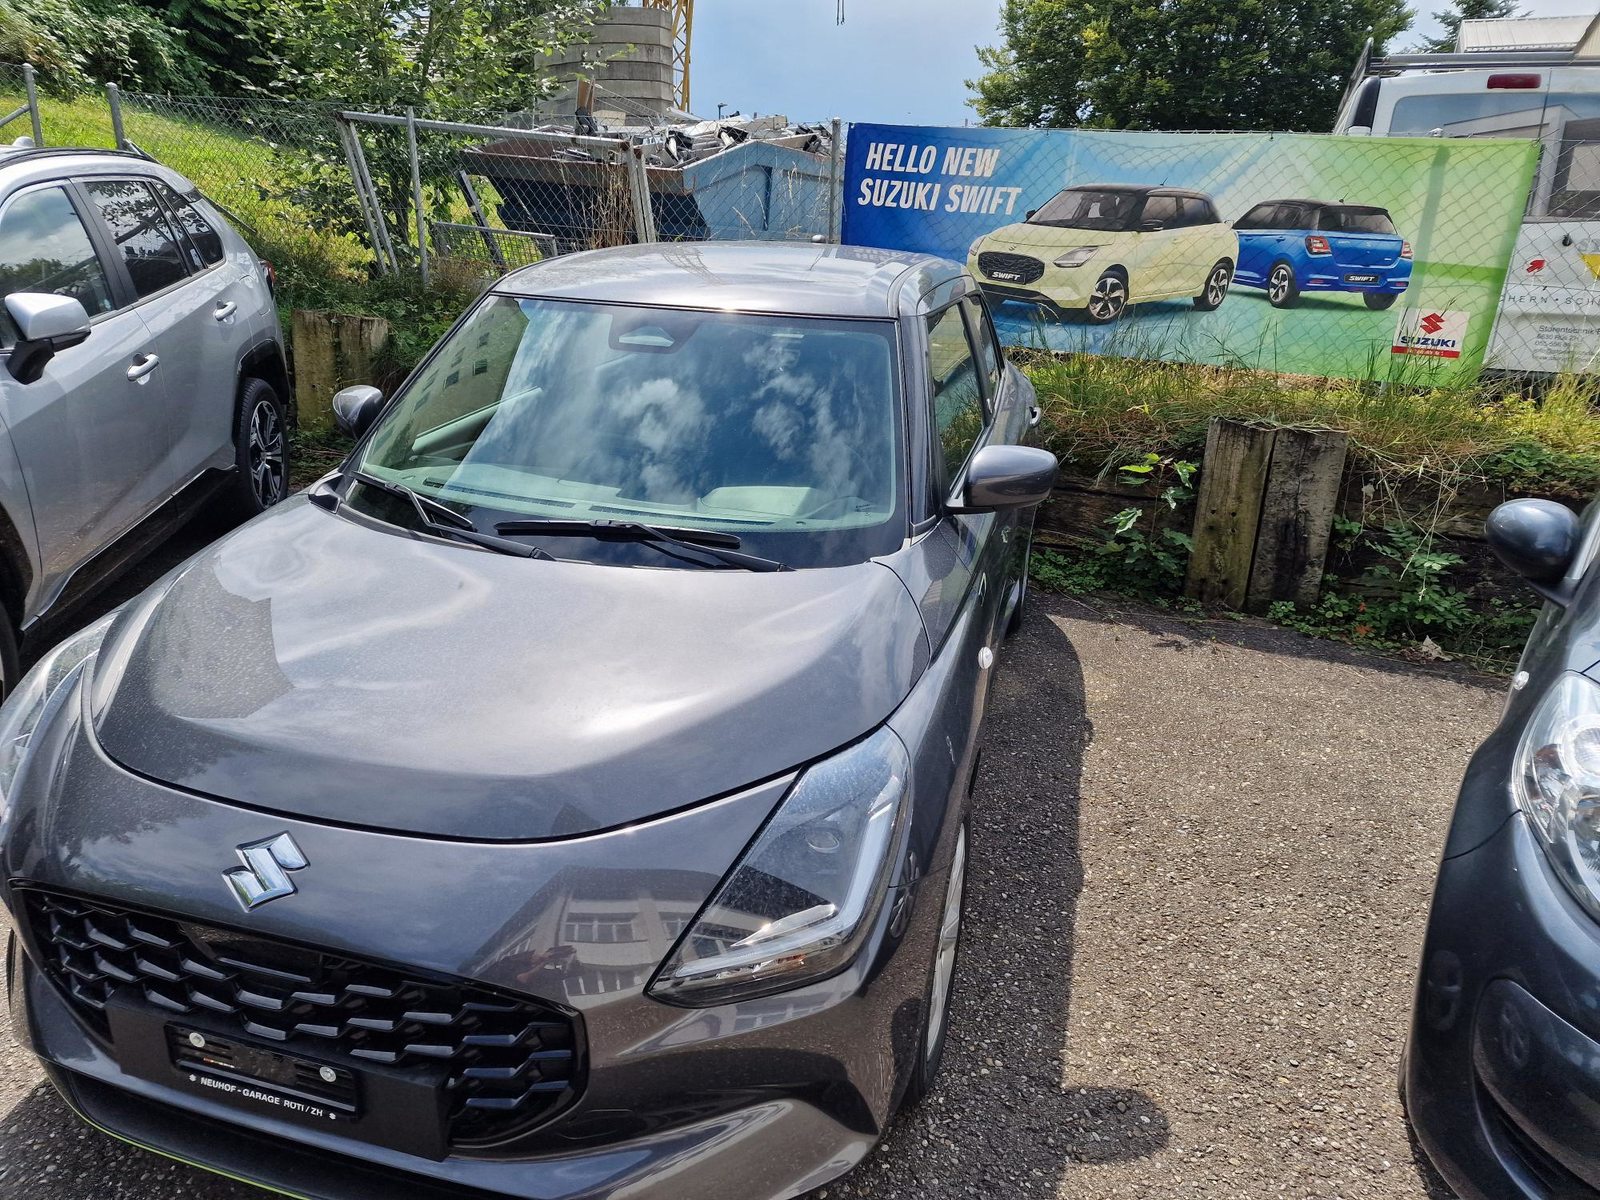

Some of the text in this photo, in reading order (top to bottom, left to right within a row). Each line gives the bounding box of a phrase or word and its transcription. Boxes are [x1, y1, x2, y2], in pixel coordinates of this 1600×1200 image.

[865, 143, 1000, 177] HELLO NEW
[858, 178, 1023, 215] SUZUKI SWIFT
[992, 271, 1021, 281] SWIFT
[1400, 335, 1456, 348] SUZUKI
